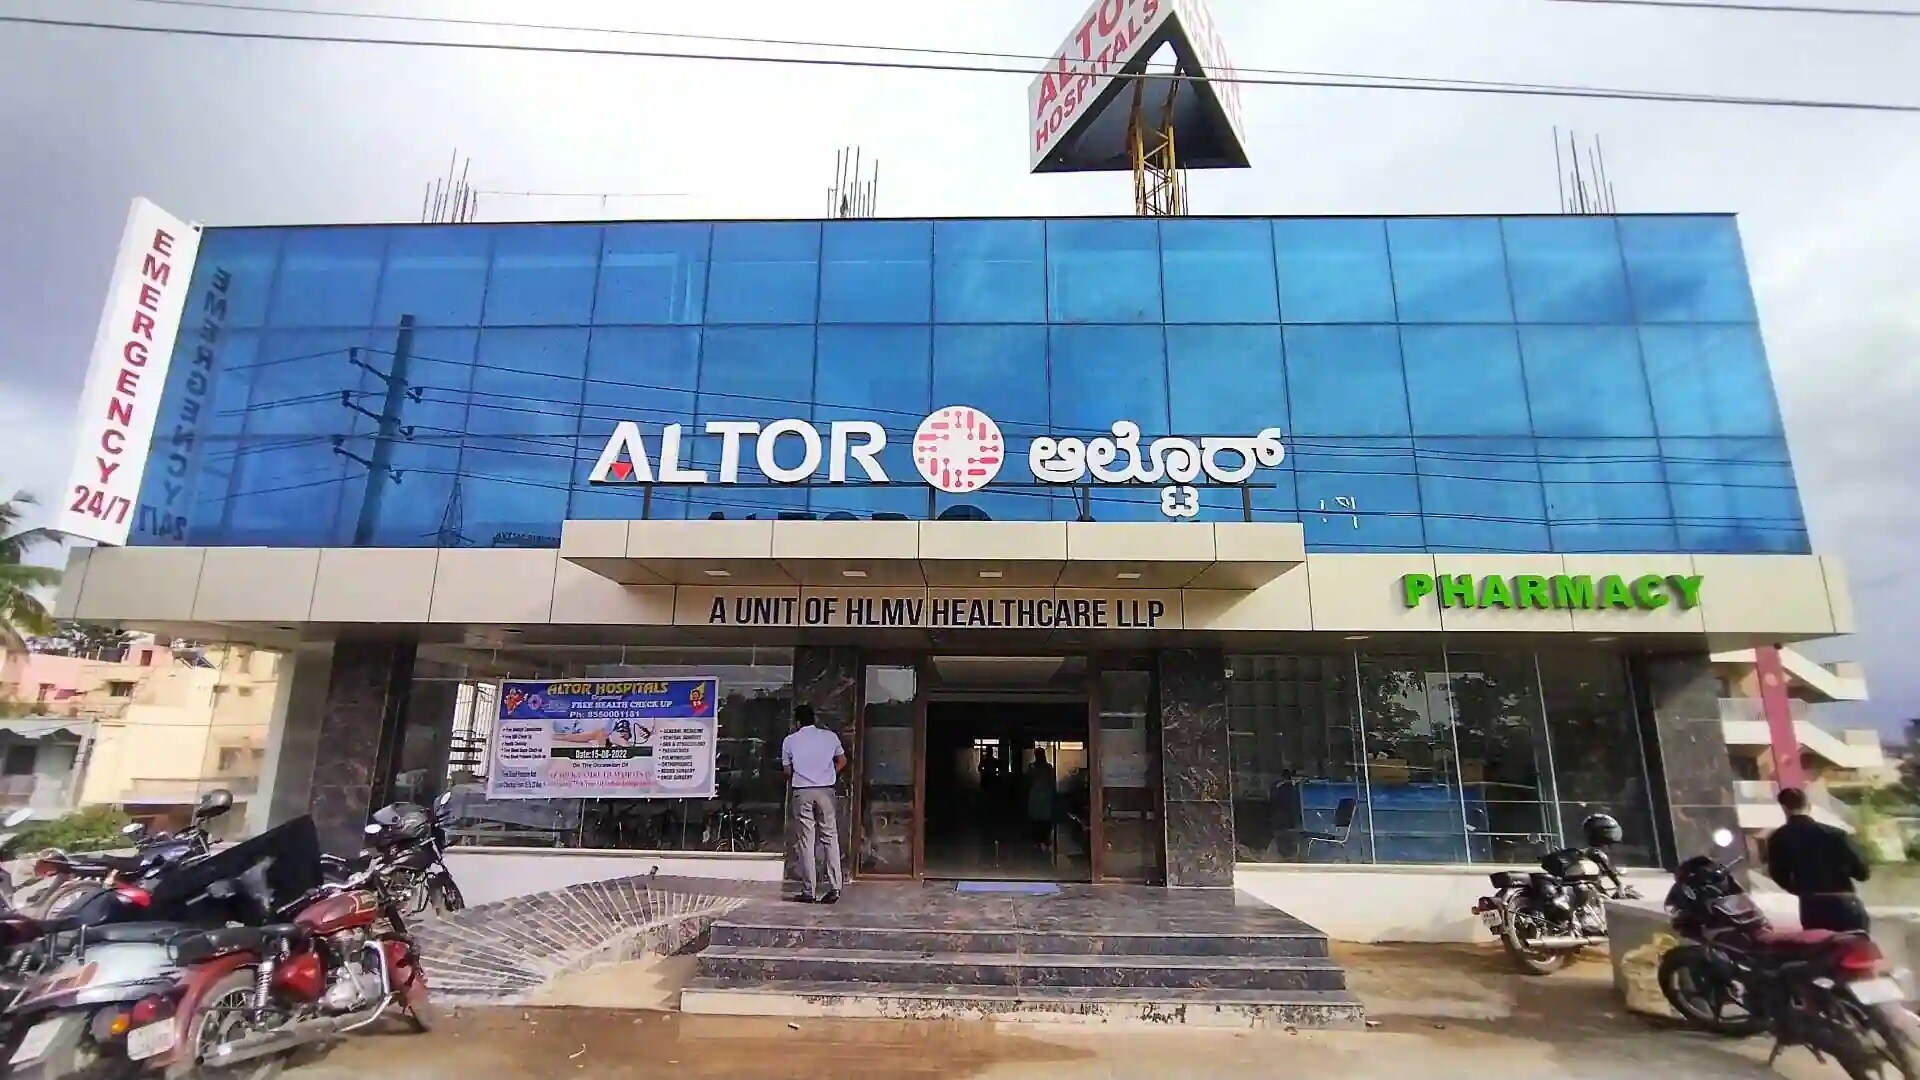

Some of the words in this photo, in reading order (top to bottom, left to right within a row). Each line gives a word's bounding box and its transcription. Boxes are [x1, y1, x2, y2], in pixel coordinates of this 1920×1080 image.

[1036, 0, 1159, 152] HOSPITALS
[1037, 0, 1136, 120] ALTO
[96, 228, 175, 484] EMERGENCY
[588, 420, 889, 483] ALTOR
[70, 485, 131, 524] 24/7
[1402, 573, 1704, 609] PHARMACY
[709, 597, 727, 624] A
[736, 597, 798, 624] UNIT
[804, 598, 837, 625] OF
[846, 598, 926, 626] HLMV
[932, 599, 1107, 628] HEALTHCARE
[1117, 600, 1164, 628] LLP
[547, 683, 592, 695] ALTOR
[595, 682, 669, 695] HOSPITALS
[595, 700, 628, 708] HEALTH
[629, 700, 657, 708] CHECK
